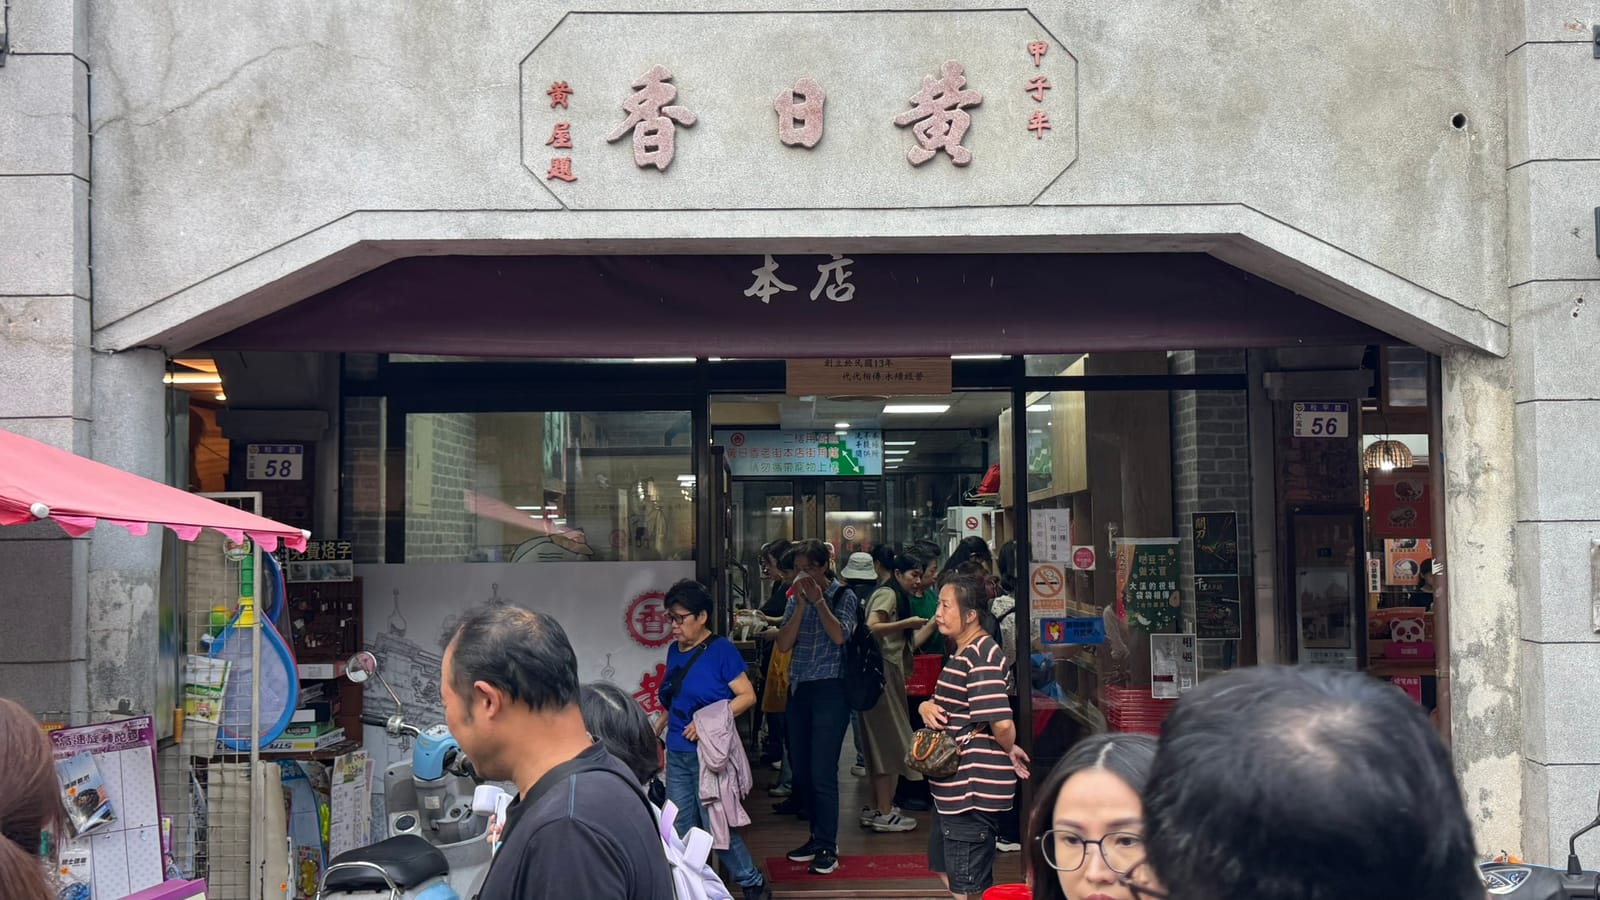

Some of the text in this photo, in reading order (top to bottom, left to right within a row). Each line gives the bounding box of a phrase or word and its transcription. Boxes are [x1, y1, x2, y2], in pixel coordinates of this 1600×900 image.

[1025, 41, 1053, 140] 甲子年
[743, 254, 856, 304] 本店
[1311, 416, 1338, 436] 56
[264, 459, 292, 478] 58
